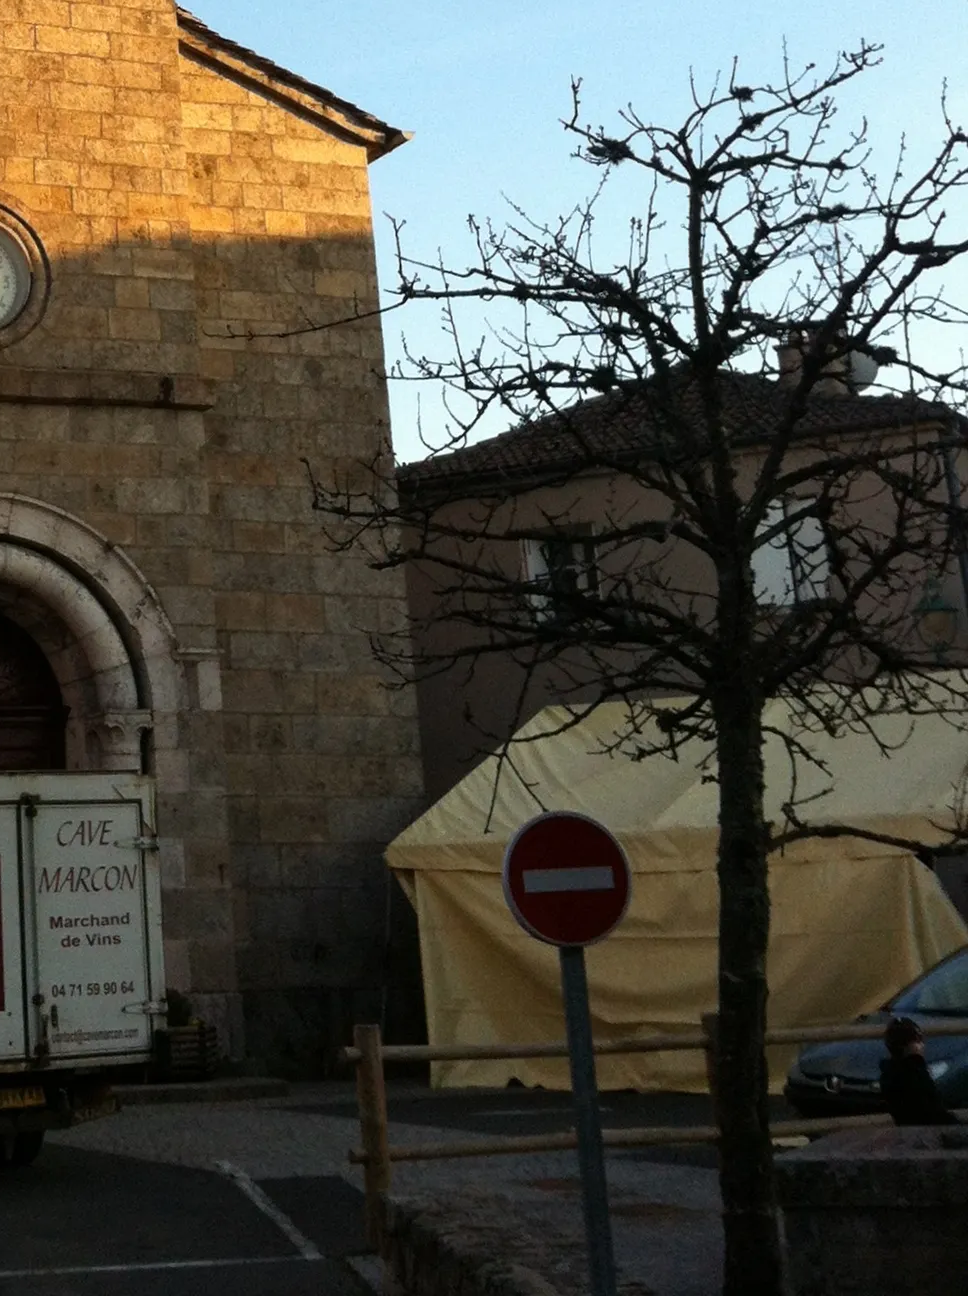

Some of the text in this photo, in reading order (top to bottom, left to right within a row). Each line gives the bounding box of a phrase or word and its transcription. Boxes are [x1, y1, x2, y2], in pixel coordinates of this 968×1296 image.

[2, 276, 10, 289] 3
[56, 819, 114, 847] CAVE
[38, 864, 139, 894] MARCON
[49, 912, 131, 930] Marchand
[61, 933, 122, 948] de Vins
[51, 981, 135, 998] 04 71 59 90 64
